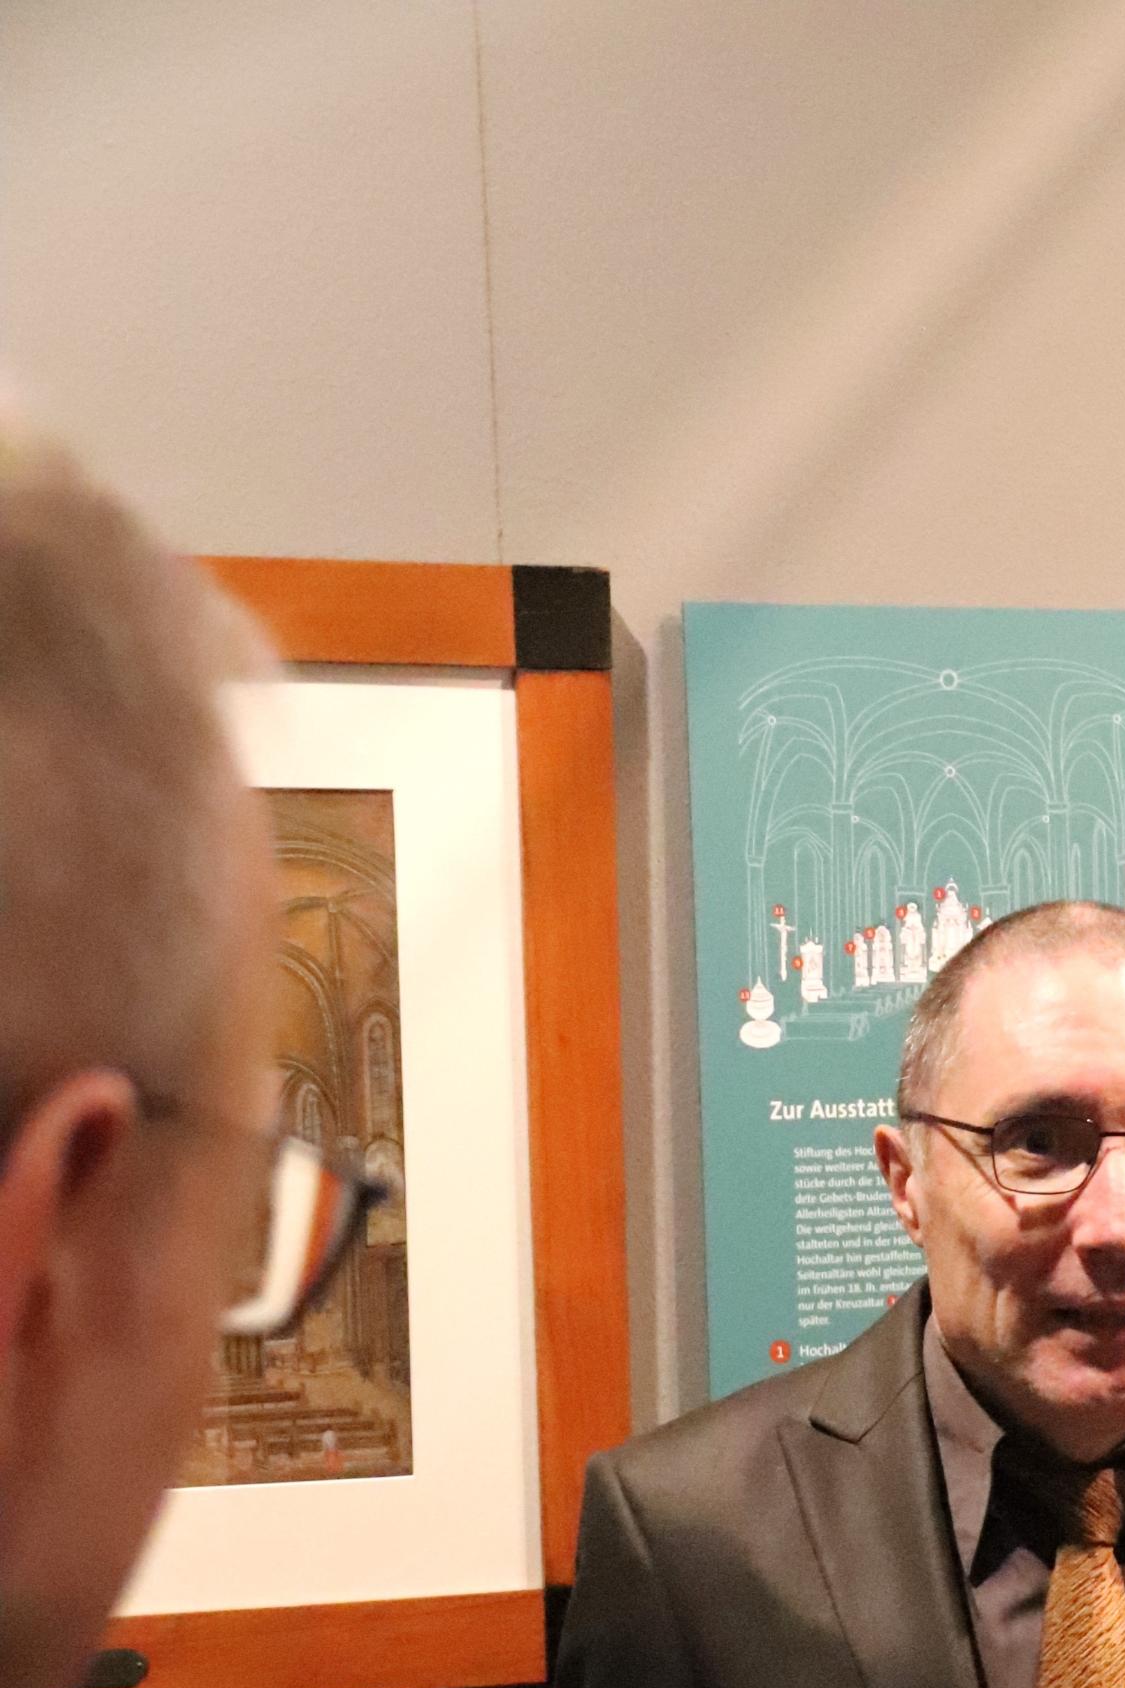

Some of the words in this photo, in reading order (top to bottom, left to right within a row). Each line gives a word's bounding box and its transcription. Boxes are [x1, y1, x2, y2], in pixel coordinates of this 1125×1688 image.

[770, 1101, 804, 1120] Zur
[810, 1100, 894, 1118] Ausstatt
[794, 1148, 832, 1160] Stiftung
[835, 1147, 852, 1156] des
[794, 1163, 822, 1173] sowie
[825, 1162, 864, 1172] weiterer
[795, 1178, 825, 1188] stücke
[828, 1177, 855, 1187] durch
[858, 1177, 874, 1186] die
[795, 1194, 816, 1204] dete
[796, 1208, 864, 1220] Allerheiligsten
[796, 1224, 812, 1234] Die
[814, 1222, 872, 1236] weitgehend
[796, 1240, 839, 1249] stalteten
[842, 1238, 860, 1247] und
[864, 1238, 872, 1246] in
[875, 1237, 890, 1246] der
[797, 1255, 843, 1264] Hochaltar
[846, 1253, 862, 1262] hin
[865, 1251, 921, 1264] gestaffelten
[798, 1269, 855, 1280] Seitenaltäre
[857, 1268, 881, 1277] wohl
[798, 1286, 810, 1295] im
[814, 1285, 845, 1294] frühen
[849, 1284, 861, 1292] 18.
[798, 1302, 814, 1311] nur
[817, 1300, 833, 1309] der
[836, 1298, 885, 1308] Kreuzaltar
[798, 1316, 829, 1327] später.
[777, 1346, 783, 1358] 1
